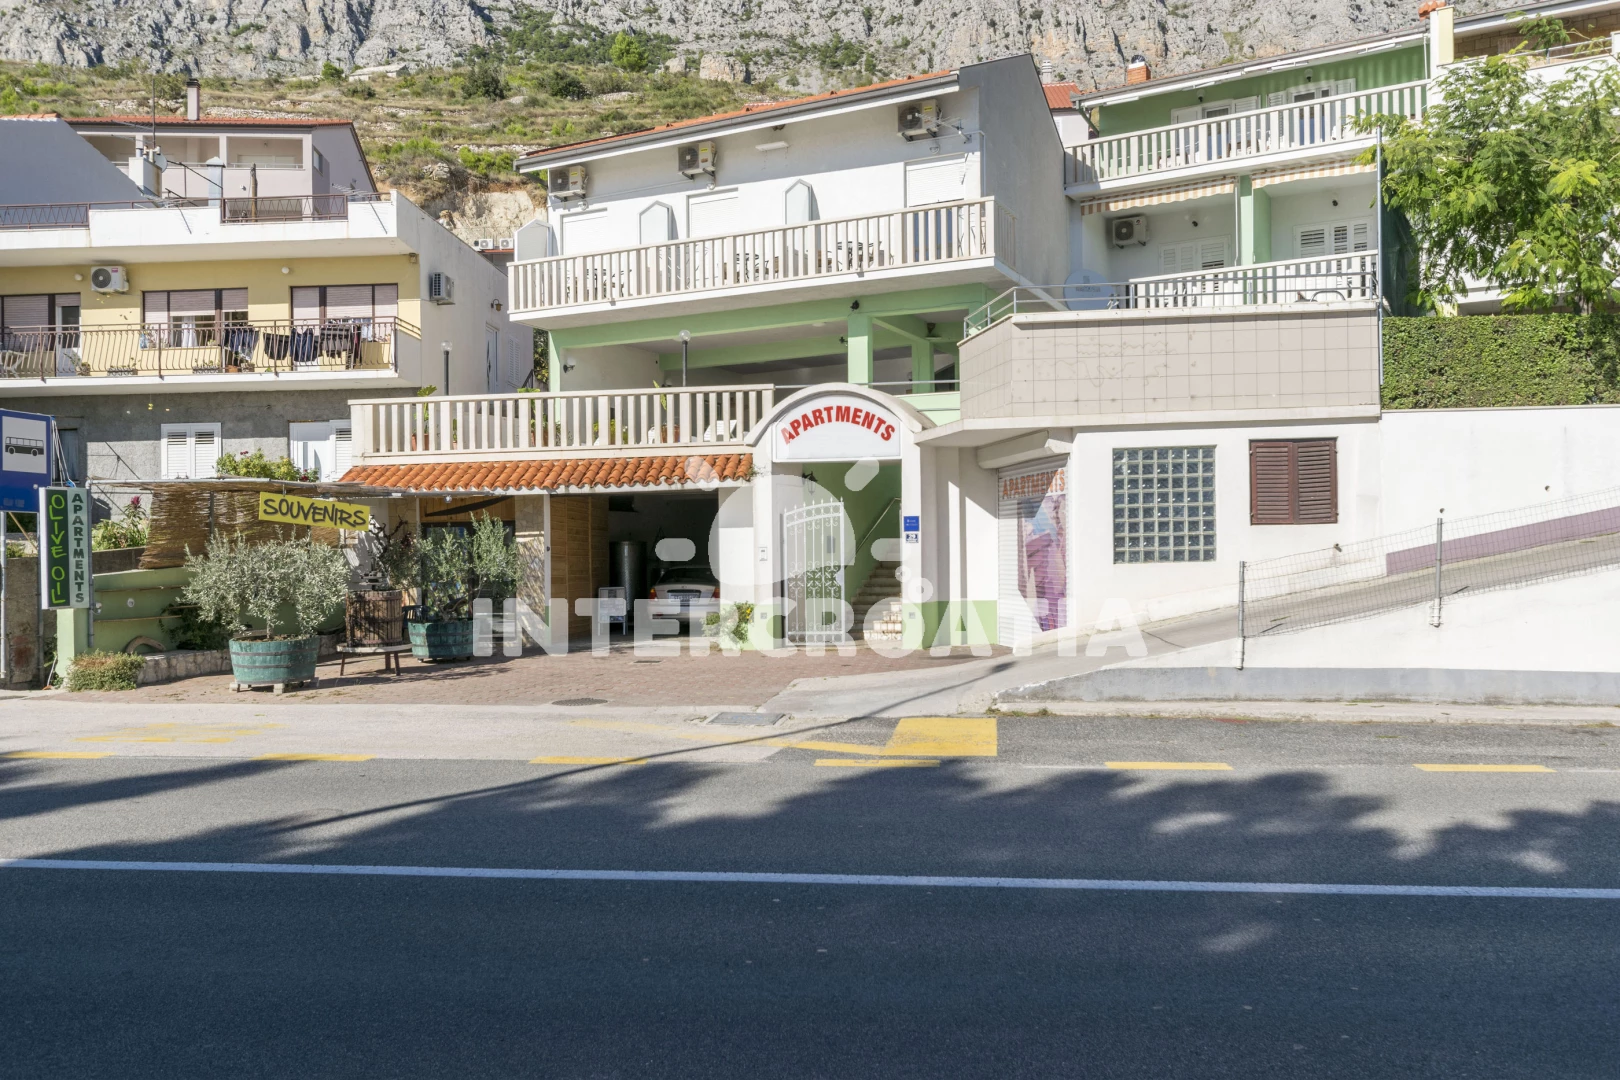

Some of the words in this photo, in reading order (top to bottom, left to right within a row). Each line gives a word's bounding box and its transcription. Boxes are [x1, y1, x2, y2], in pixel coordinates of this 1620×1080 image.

[780, 405, 895, 445] APARTMENTS
[1002, 469, 1065, 499] APARTMENTS
[49, 494, 67, 559] OLIVE
[263, 498, 367, 528] SOUVENIRS
[71, 493, 85, 603] APARTMENTS
[51, 566, 66, 604] OIL
